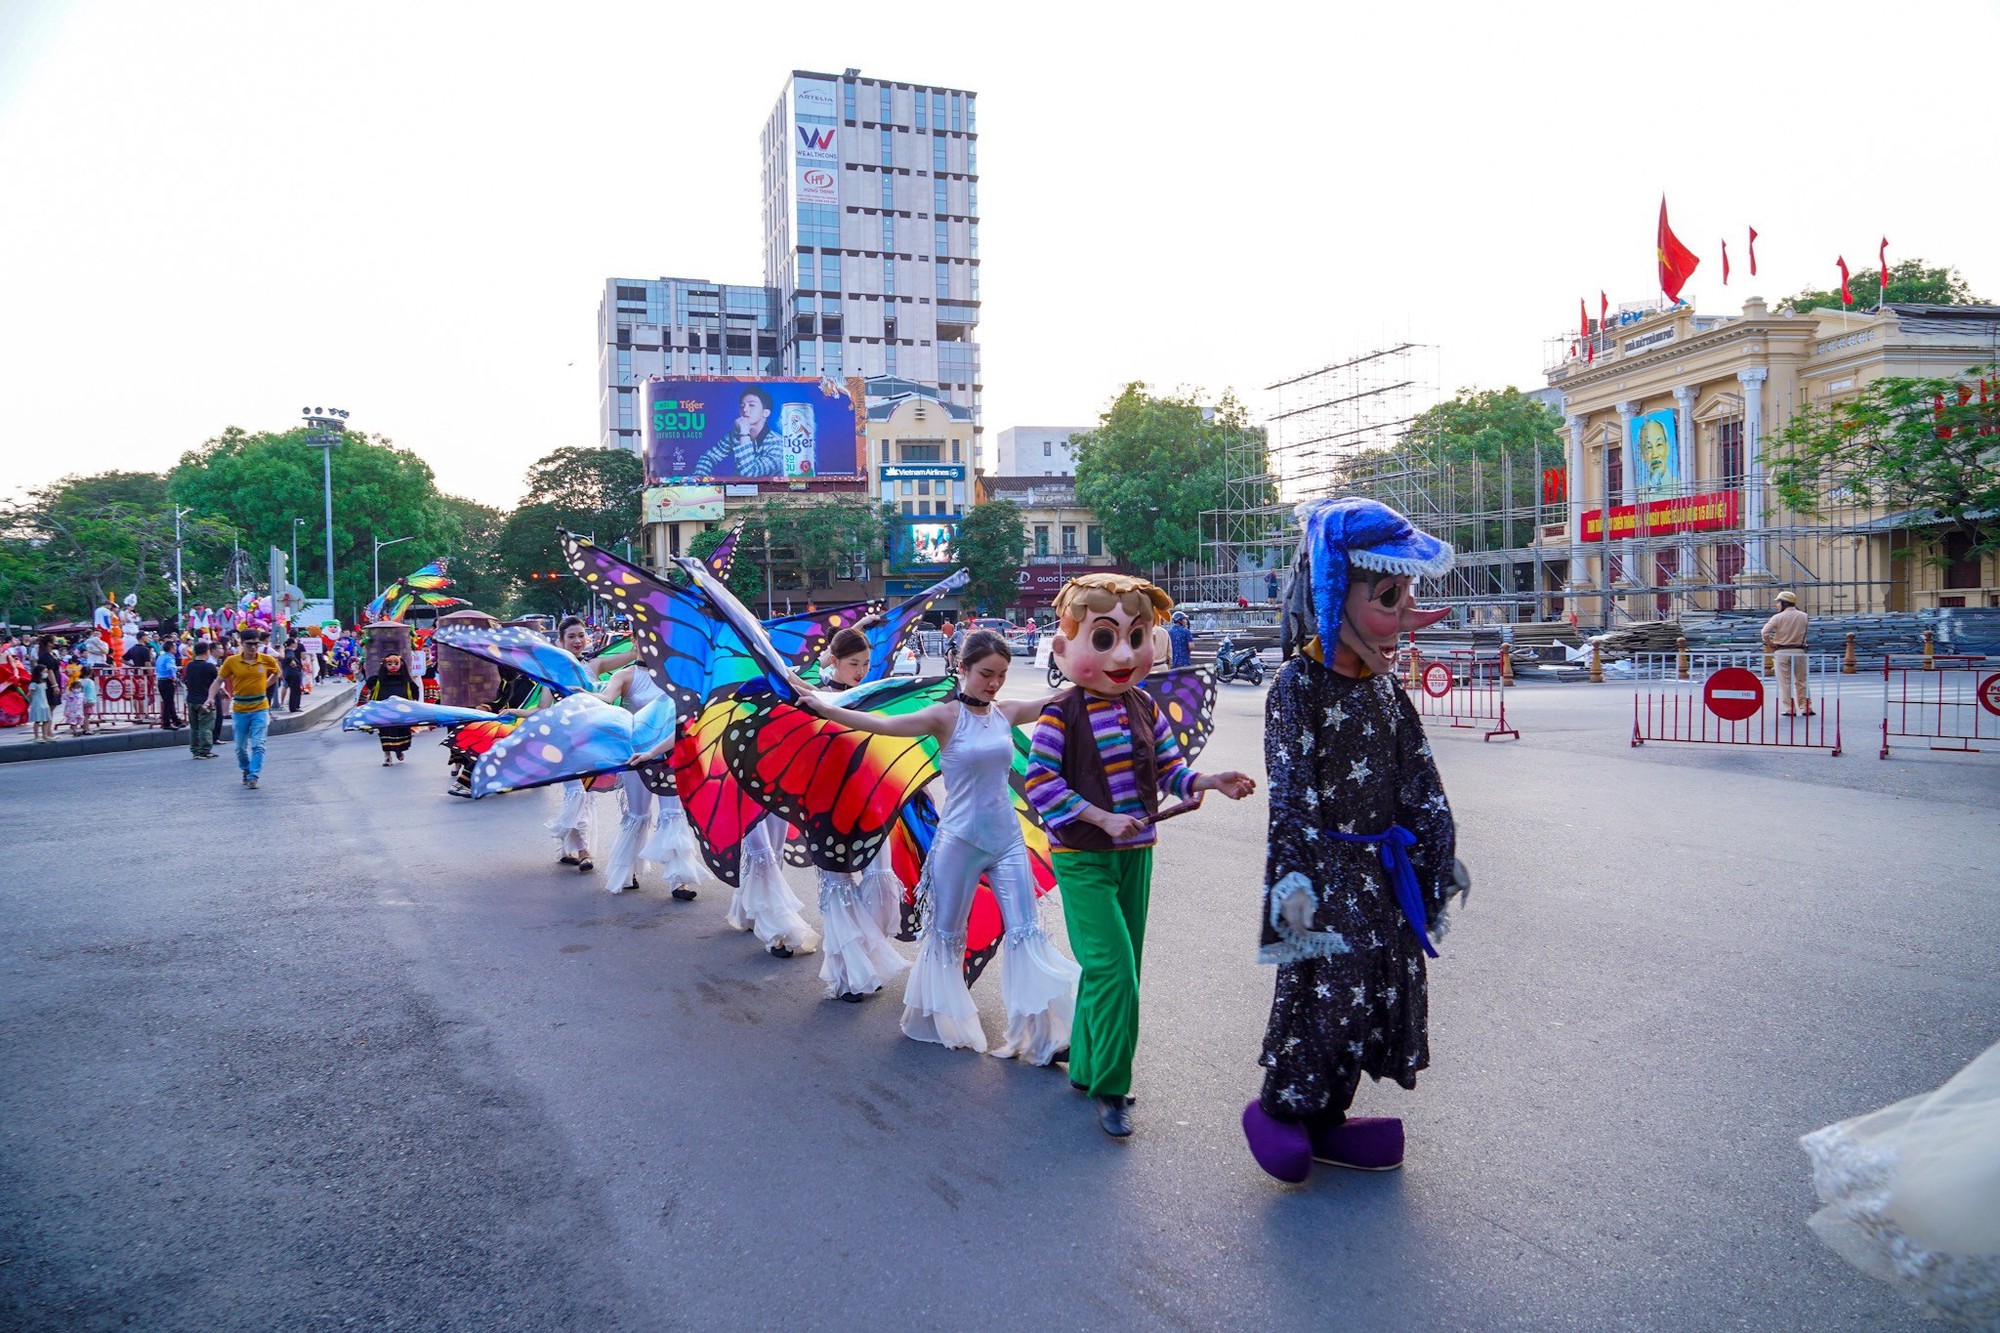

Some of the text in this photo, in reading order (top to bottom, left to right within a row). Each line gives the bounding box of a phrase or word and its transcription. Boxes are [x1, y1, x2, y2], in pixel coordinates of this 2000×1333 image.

[798, 94, 834, 102] ARTELIA
[796, 150, 837, 159] WEALTHCONS
[679, 399, 705, 413] Tiger
[653, 412, 706, 432] SOJU
[682, 431, 704, 439] LAGER
[783, 433, 813, 454] Tiger
[898, 468, 950, 476] Vietnam Airlines
